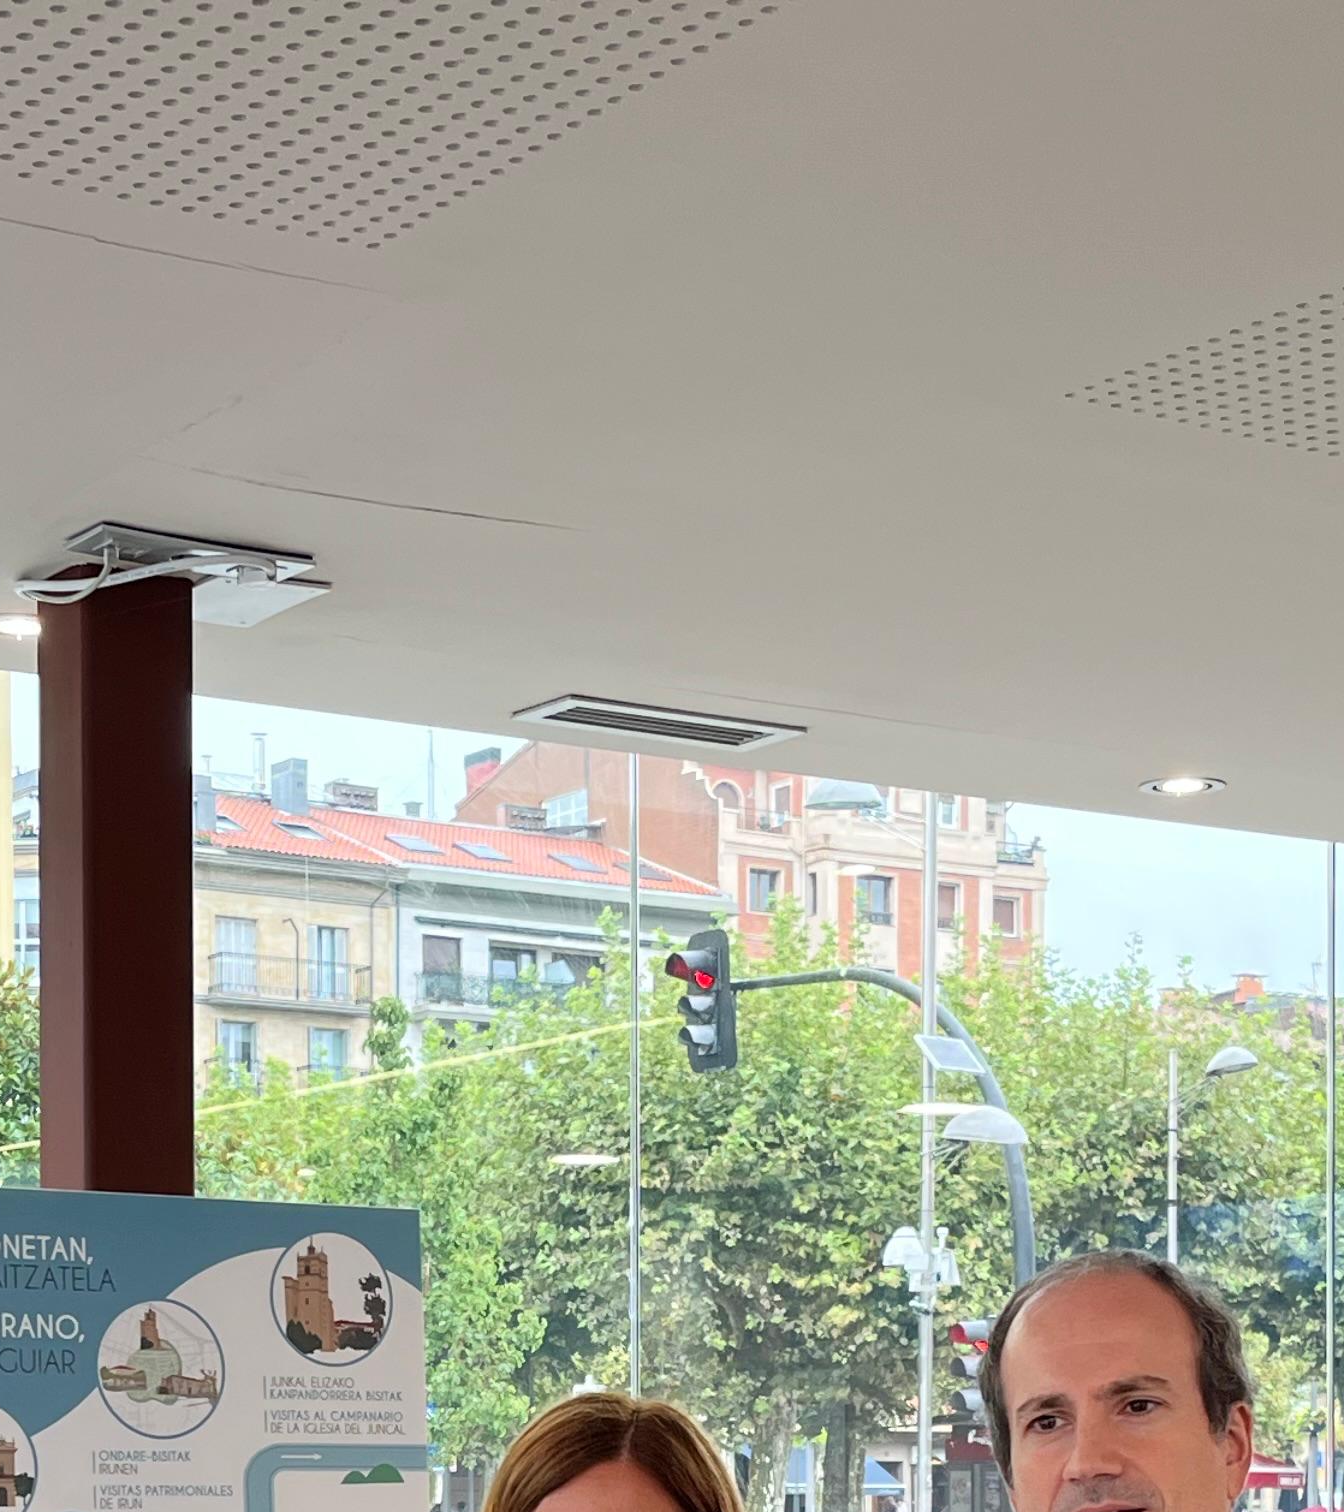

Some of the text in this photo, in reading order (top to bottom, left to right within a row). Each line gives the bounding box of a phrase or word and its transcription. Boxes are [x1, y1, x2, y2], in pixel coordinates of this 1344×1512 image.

[270, 1375, 355, 1389] JUNKAL ELIZAKO
[269, 1388, 404, 1402] KANPANDORRERA BISITAK
[270, 1409, 404, 1423] VISITAS AL CAMPANARIO
[270, 1422, 406, 1436] DE LA IGLESIA DEL JUNCAL
[99, 1450, 192, 1462] ONDARE-BISITAK
[99, 1463, 139, 1476] IRUNEN
[100, 1485, 233, 1497] VISITAS PATRIMONIALES
[100, 1498, 143, 1510] DE IRUN
